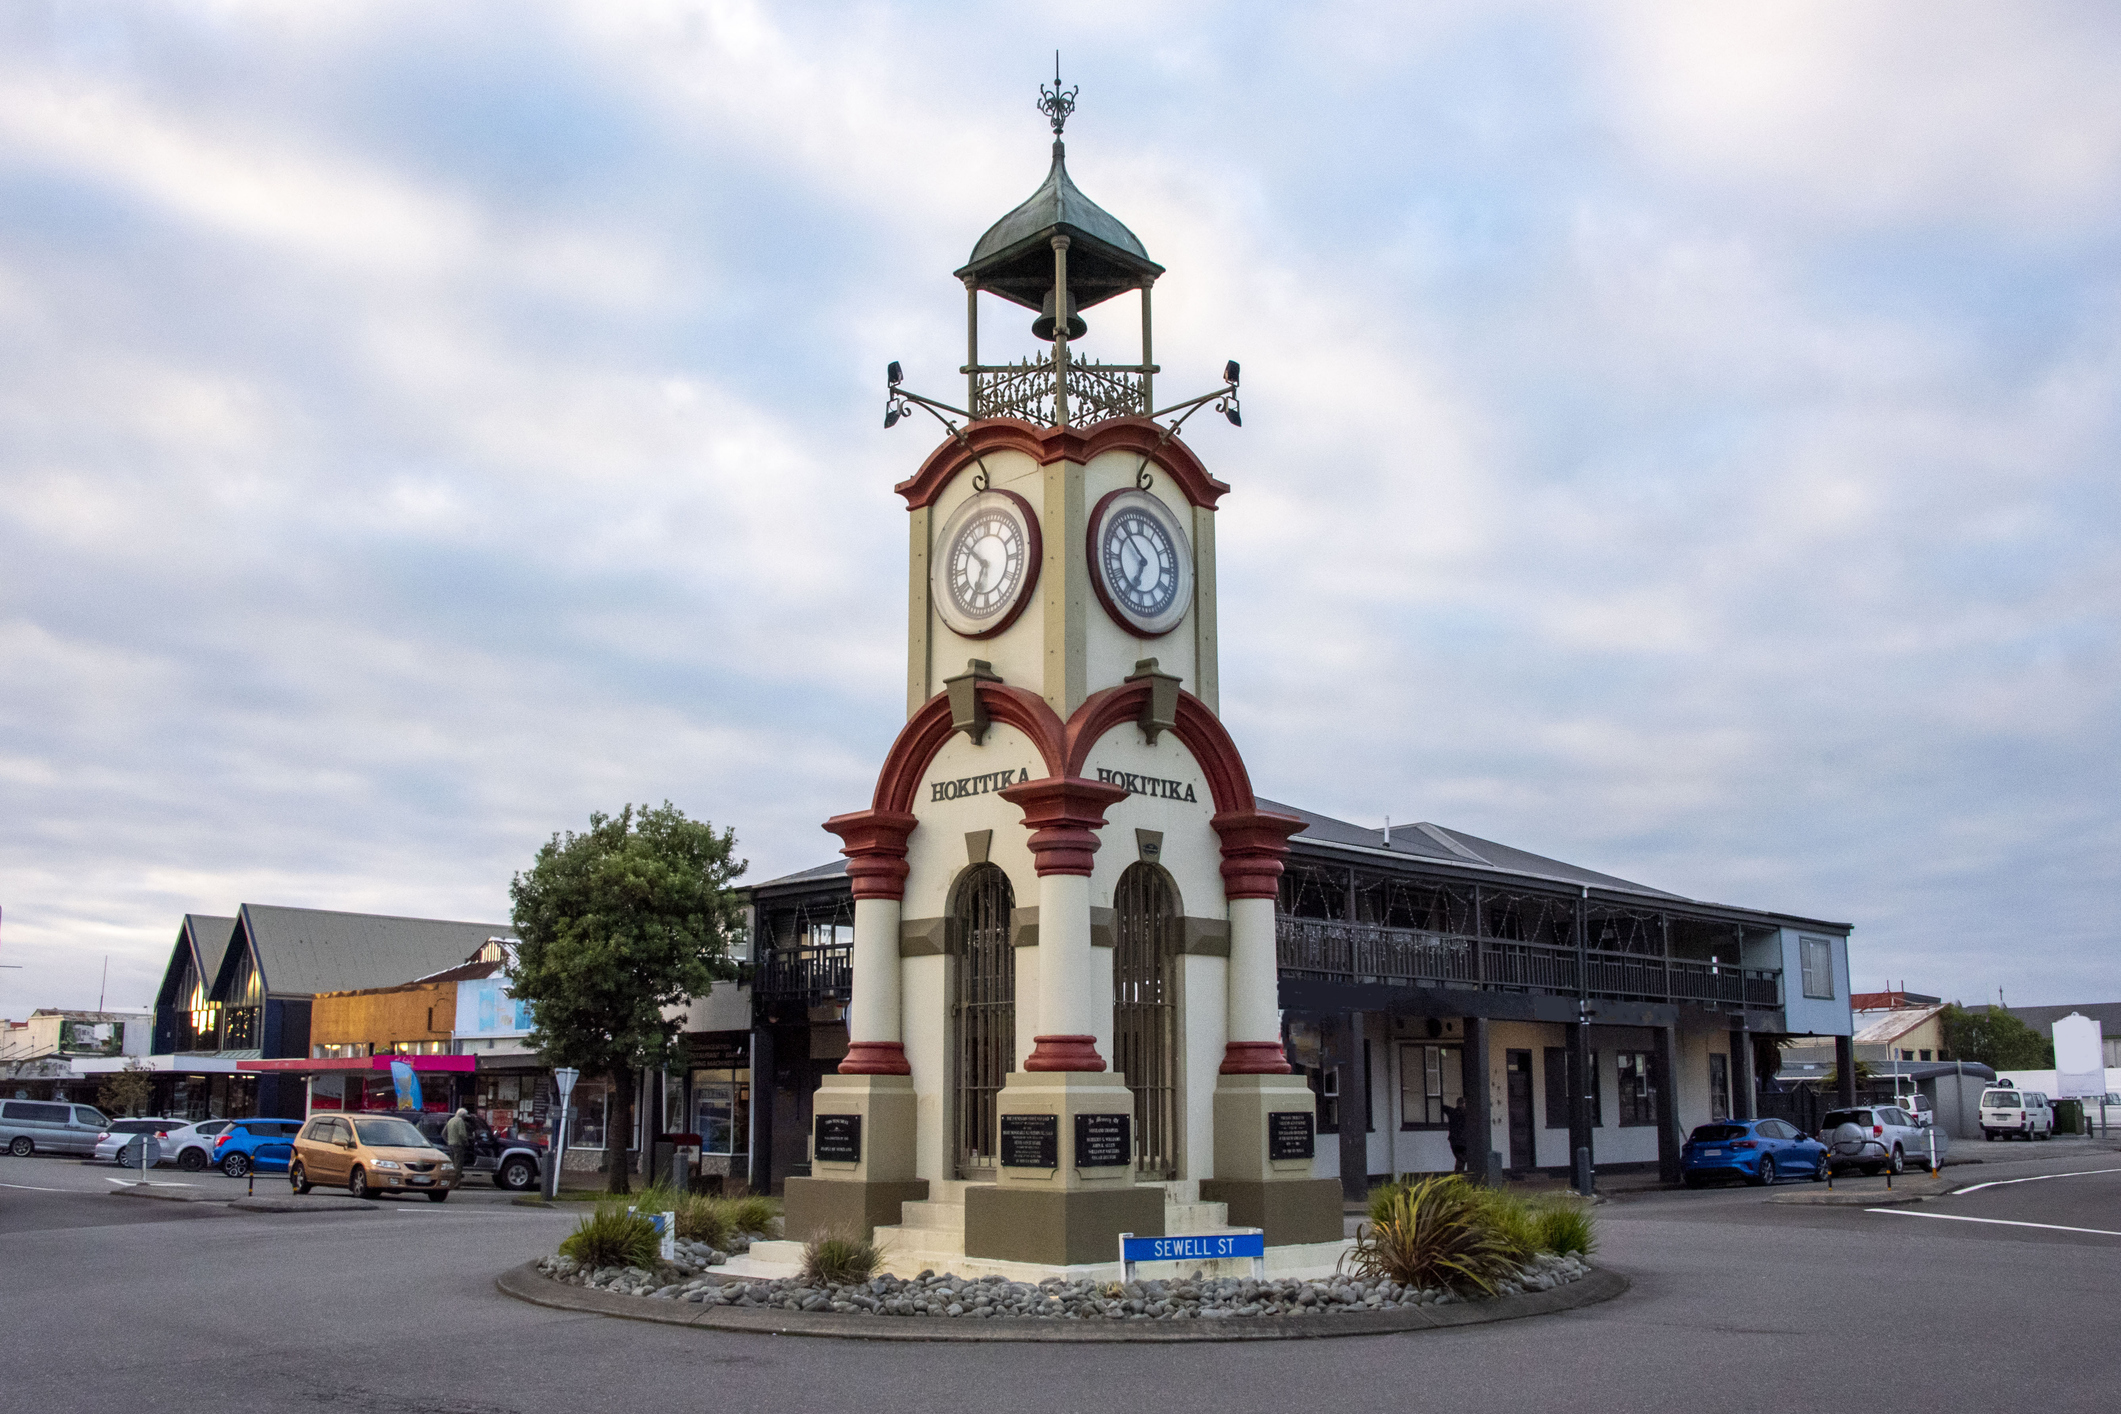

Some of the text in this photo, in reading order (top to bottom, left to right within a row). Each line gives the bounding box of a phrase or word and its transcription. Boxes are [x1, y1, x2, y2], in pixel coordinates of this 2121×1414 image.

[931, 767, 1029, 802] HOKITIKA
[1097, 768, 1198, 803] HOKITIKA
[1154, 1238, 1234, 1257] SEWELL ST
